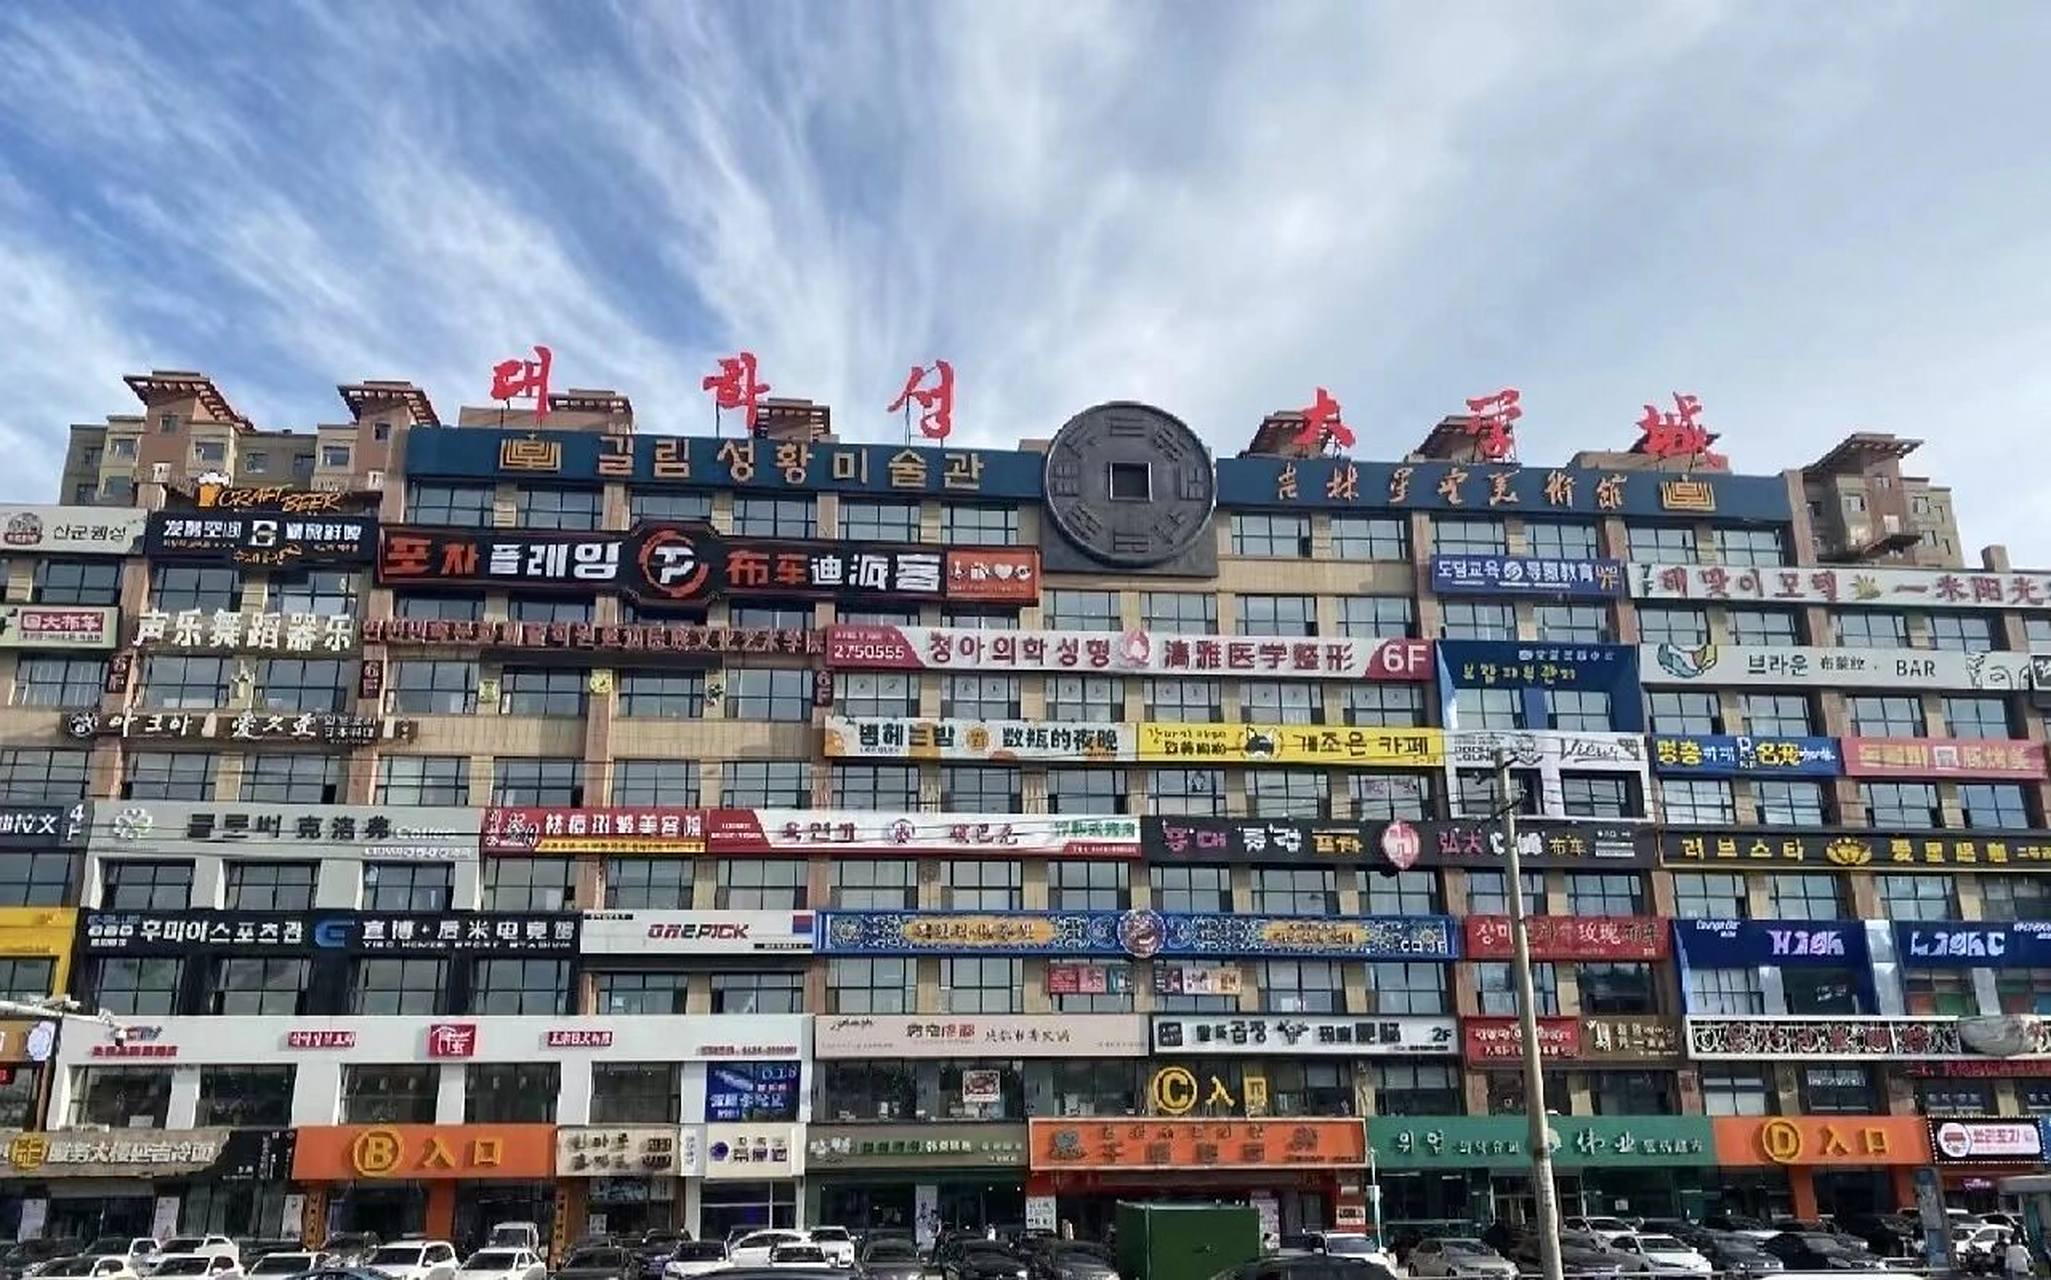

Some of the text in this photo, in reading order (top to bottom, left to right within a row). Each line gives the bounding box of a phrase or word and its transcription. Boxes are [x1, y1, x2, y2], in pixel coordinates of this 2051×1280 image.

[598, 436, 984, 490] 길림성황미술관
[219, 484, 341, 511] CRAFT BEER
[489, 540, 622, 579] 플레임
[133, 608, 353, 652] 声乐舞蹈器乐
[834, 644, 905, 660] 2750555
[930, 632, 1111, 666] 청아의학성형
[1382, 643, 1428, 673] 6F
[1747, 653, 1809, 677] 브라운
[1896, 659, 1937, 678] BAR
[1682, 837, 1805, 863] 러브스타
[1431, 1027, 1452, 1042] 2F
[1205, 1076, 1268, 1108] 入口
[422, 1136, 503, 1169] 入口
[1820, 1124, 1889, 1155] 入口
